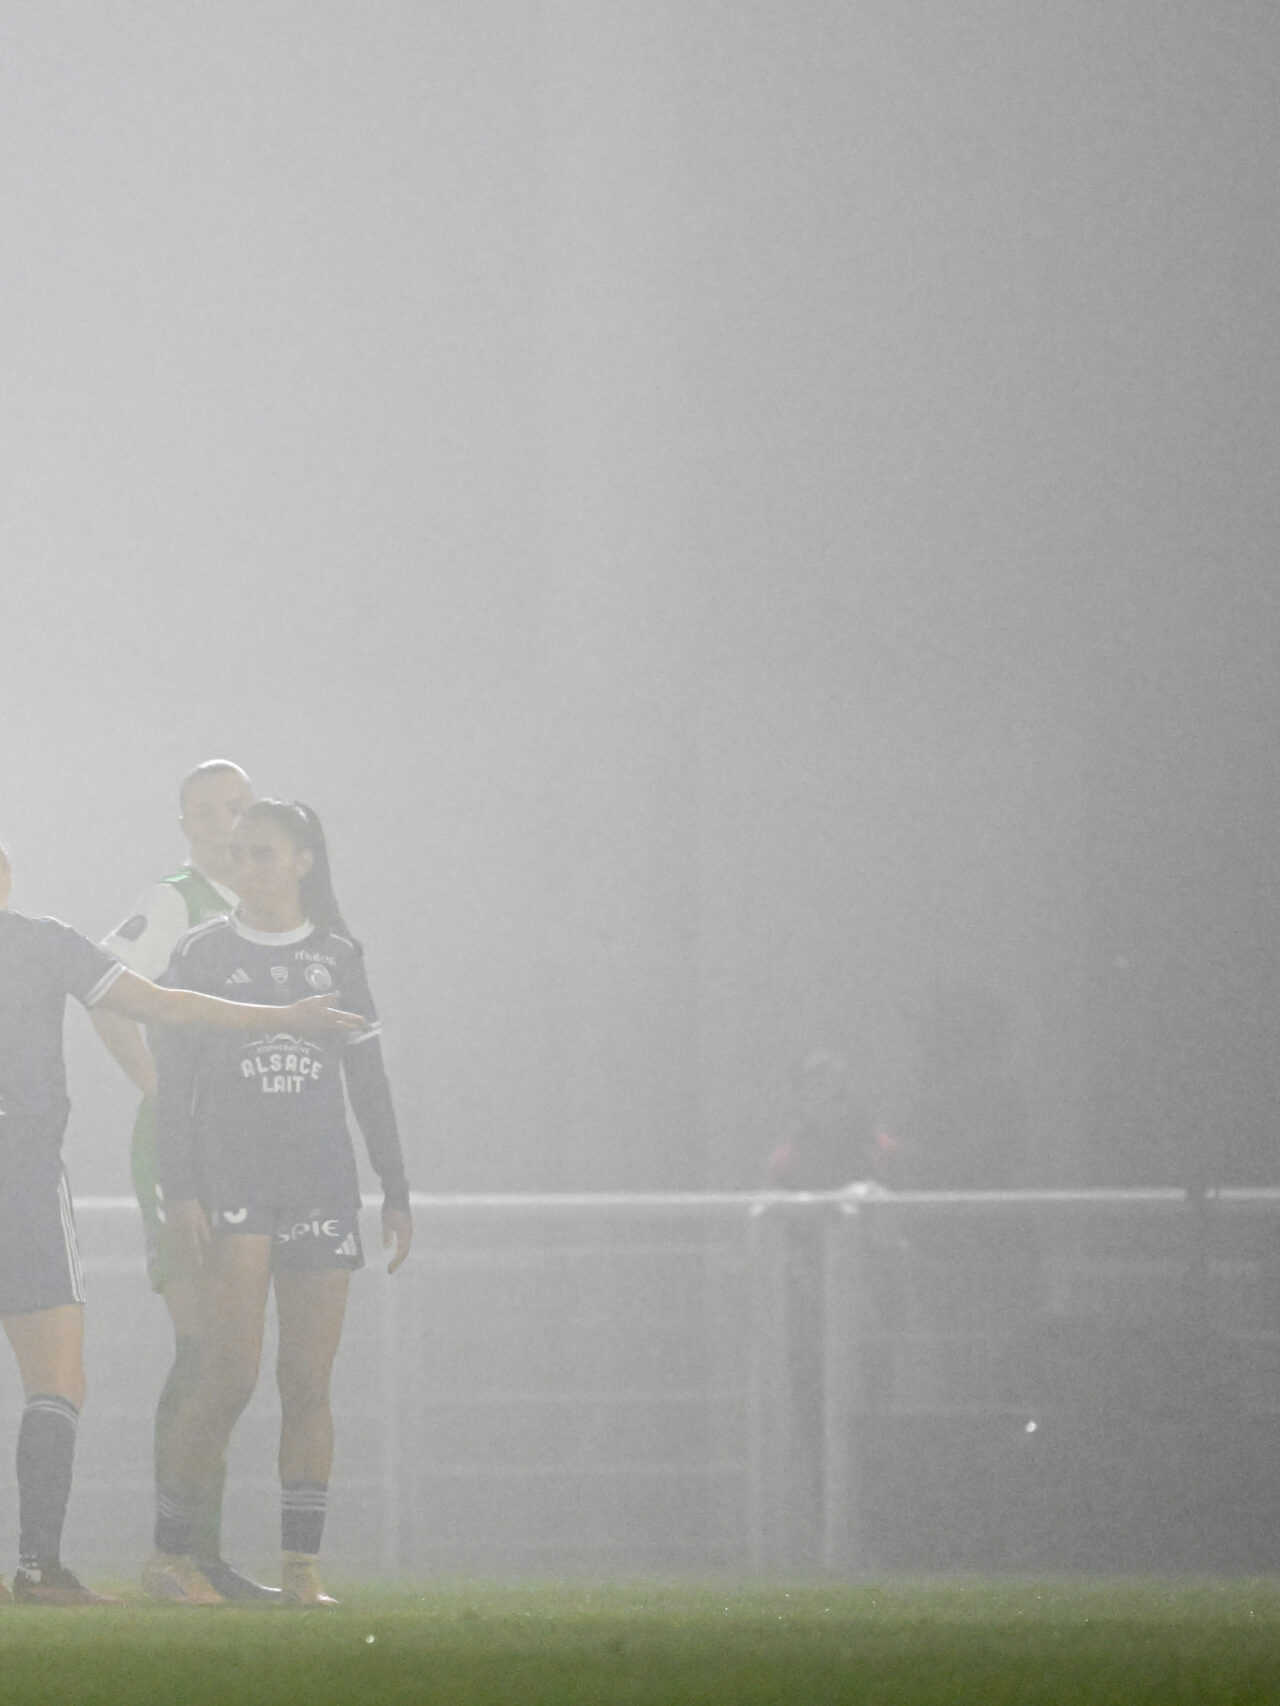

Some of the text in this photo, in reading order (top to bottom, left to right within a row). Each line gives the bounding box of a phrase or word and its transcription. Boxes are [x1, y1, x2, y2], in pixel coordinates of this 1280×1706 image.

[240, 1053, 323, 1080] ALSACE
[262, 1075, 305, 1093] LAIT
[276, 1219, 340, 1244] SPIE
